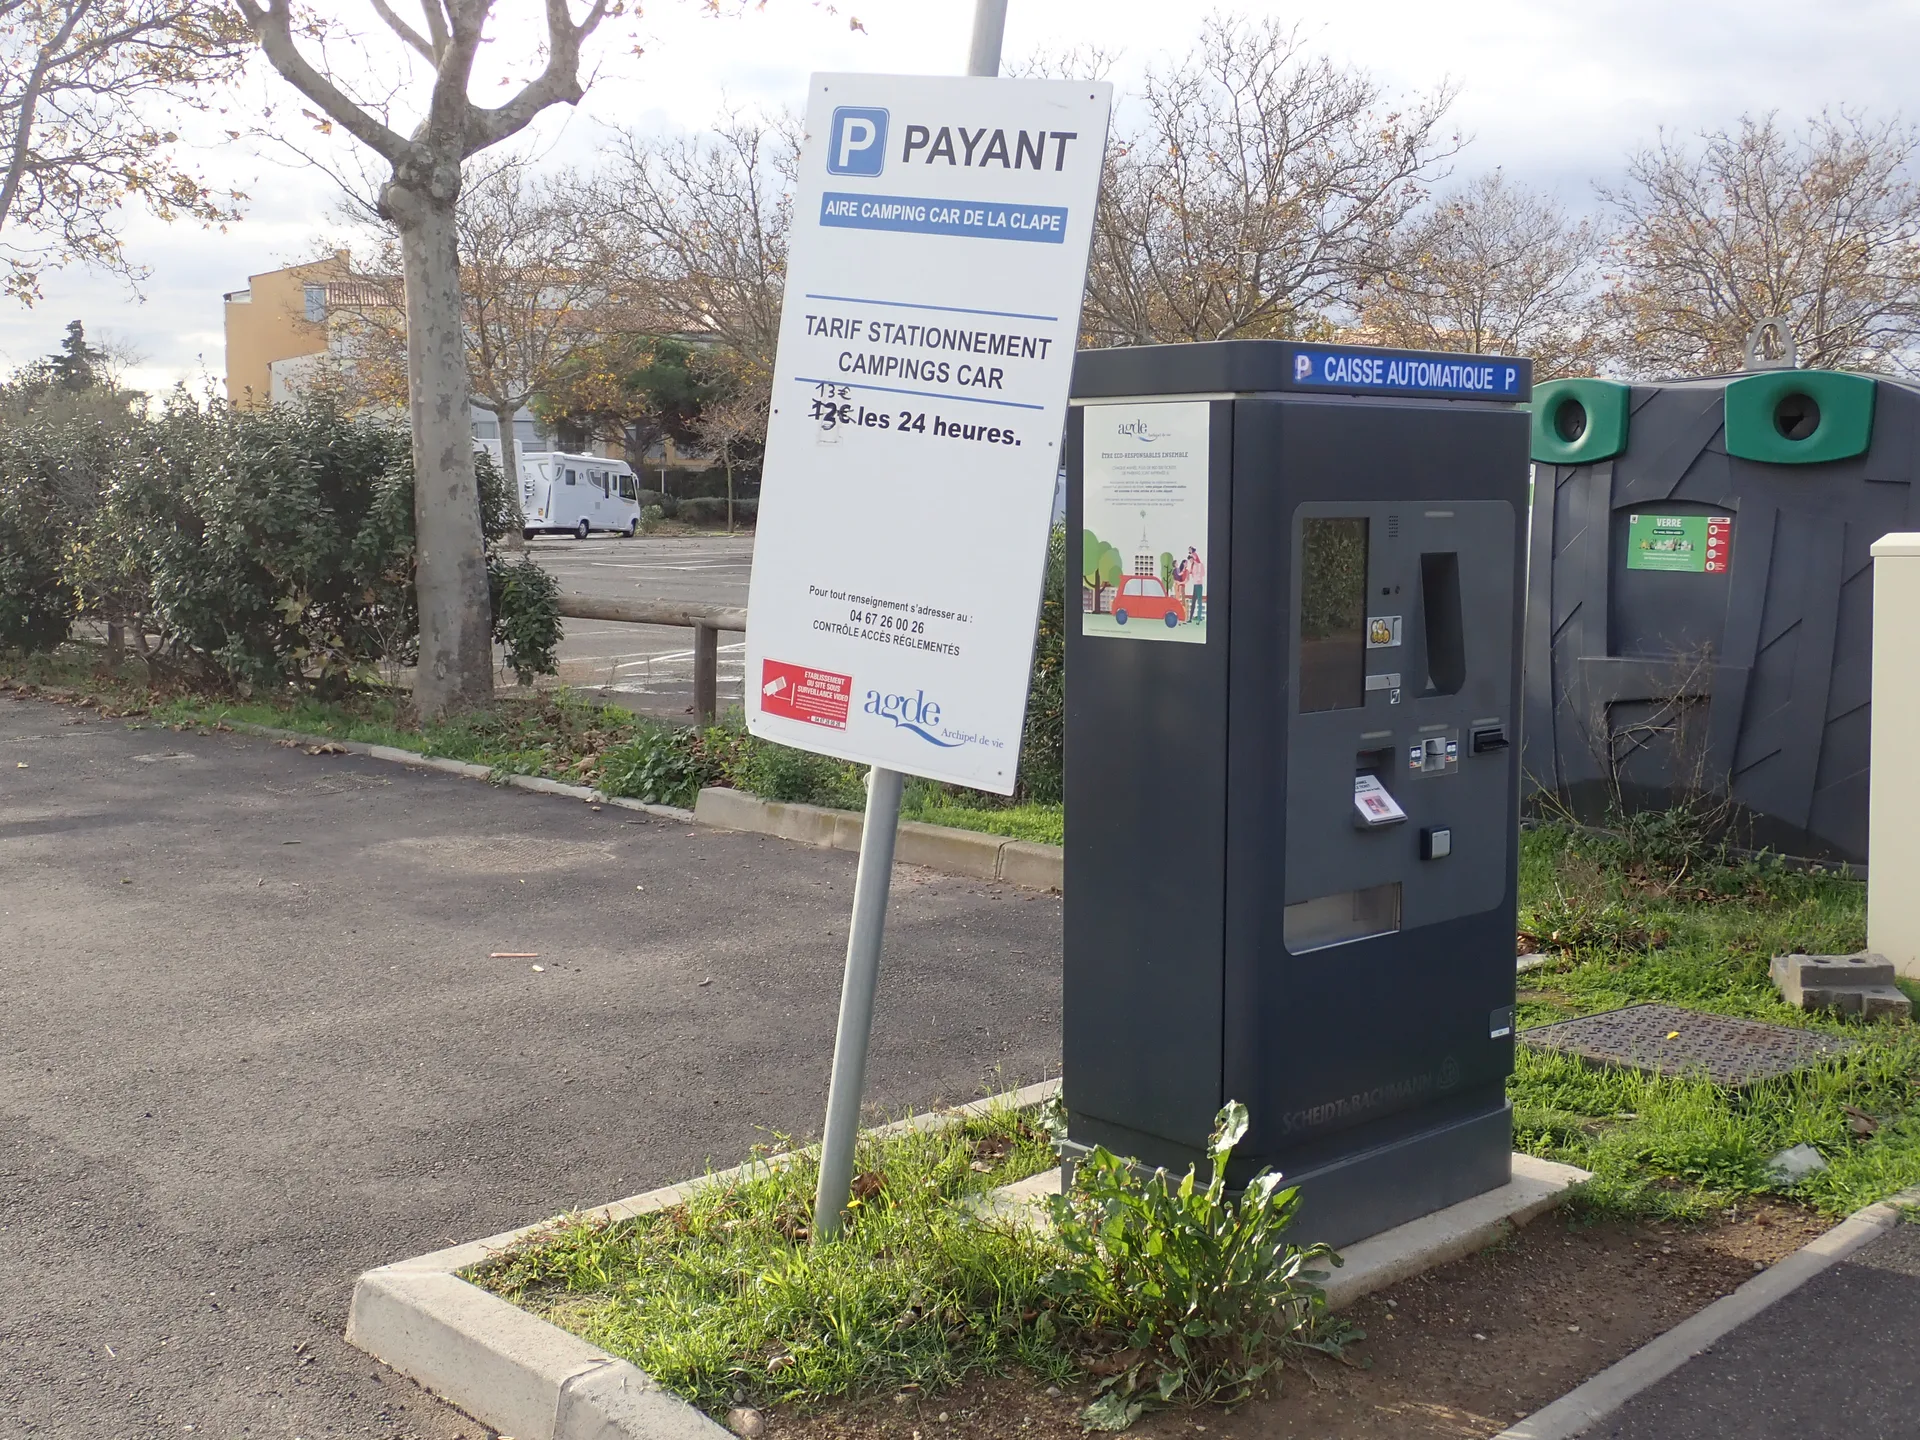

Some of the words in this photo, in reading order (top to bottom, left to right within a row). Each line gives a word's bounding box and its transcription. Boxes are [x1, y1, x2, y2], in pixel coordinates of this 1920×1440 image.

[839, 117, 876, 167] P
[902, 124, 1078, 172] PAYANT
[825, 200, 858, 217] AIRE
[861, 202, 926, 222] CAMPING
[929, 207, 960, 224] CAR
[963, 209, 985, 226] DE
[987, 211, 1007, 228] LA
[1010, 213, 1061, 231] CLAPE
[805, 314, 863, 340] TARIF
[868, 321, 1052, 360] STATIONNEMENT
[838, 351, 950, 383] CAMPINGS
[956, 364, 1004, 390] CAR
[1324, 356, 1383, 384] CAISSE
[1386, 360, 1493, 390] AUTOMATIQUE
[1505, 368, 1516, 390] P
[815, 382, 852, 400] 13€
[857, 405, 890, 430] les
[897, 411, 926, 434] 24
[933, 415, 1022, 446] heures.
[1118, 418, 1148, 438] agde
[1656, 518, 1682, 528] VERRE
[809, 585, 829, 597] Pour
[830, 588, 846, 601] tout
[847, 592, 909, 613] renseignement
[910, 602, 955, 620] s'adresser
[956, 611, 968, 622] au
[849, 608, 862, 623] 04
[865, 611, 878, 625] 67
[880, 614, 893, 629] 26
[895, 617, 909, 631] 00
[911, 620, 925, 634] 26
[812, 619, 859, 638] CONTRÔLE
[860, 628, 891, 644] ACCÈS
[892, 633, 960, 657] RÉGLEMENTÉS
[804, 670, 845, 685] ETABLISSEMENT
[806, 679, 814, 687] OU
[815, 680, 826, 690] SITE
[826, 683, 841, 693] SOUS
[797, 685, 833, 699] SURVEILLANCE
[833, 692, 849, 702] VIDEO
[863, 689, 941, 728] agde
[941, 727, 977, 743] Archipel
[979, 735, 990, 746] de
[991, 737, 1004, 749] vie
